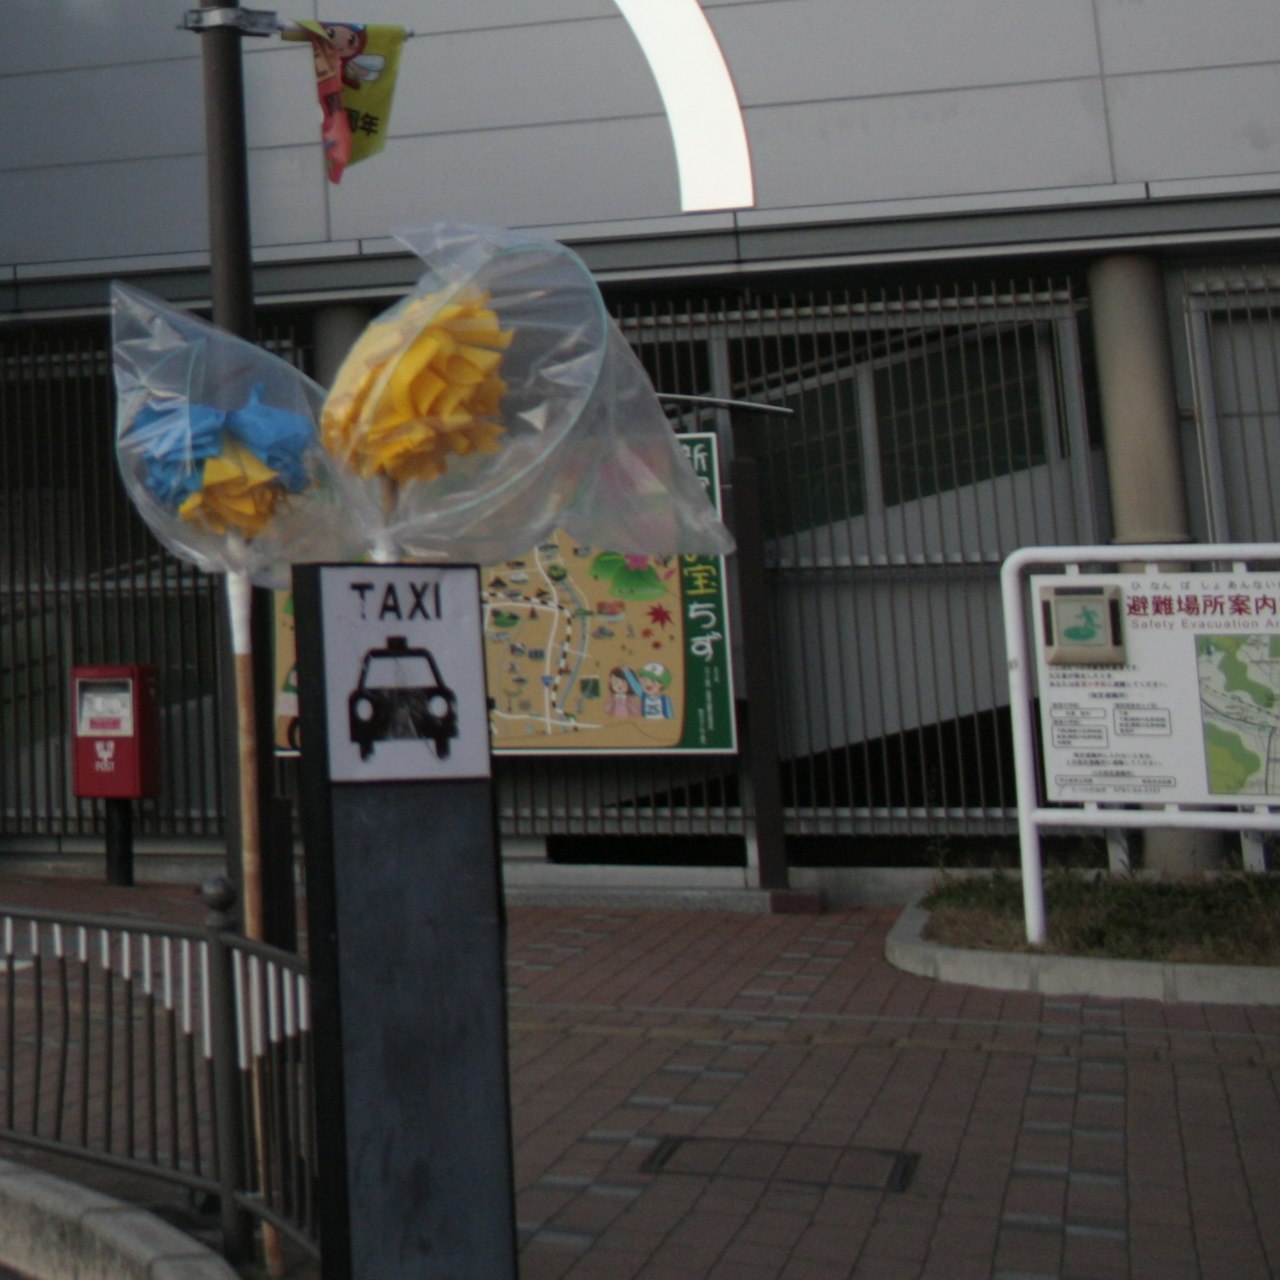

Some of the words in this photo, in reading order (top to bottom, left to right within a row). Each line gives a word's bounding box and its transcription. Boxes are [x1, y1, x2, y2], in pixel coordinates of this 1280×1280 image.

[350, 582, 443, 620] TAXI
[1126, 594, 1278, 617] 避難場所案内
[1131, 619, 1175, 629] Safety
[1181, 619, 1259, 628] Evacuation
